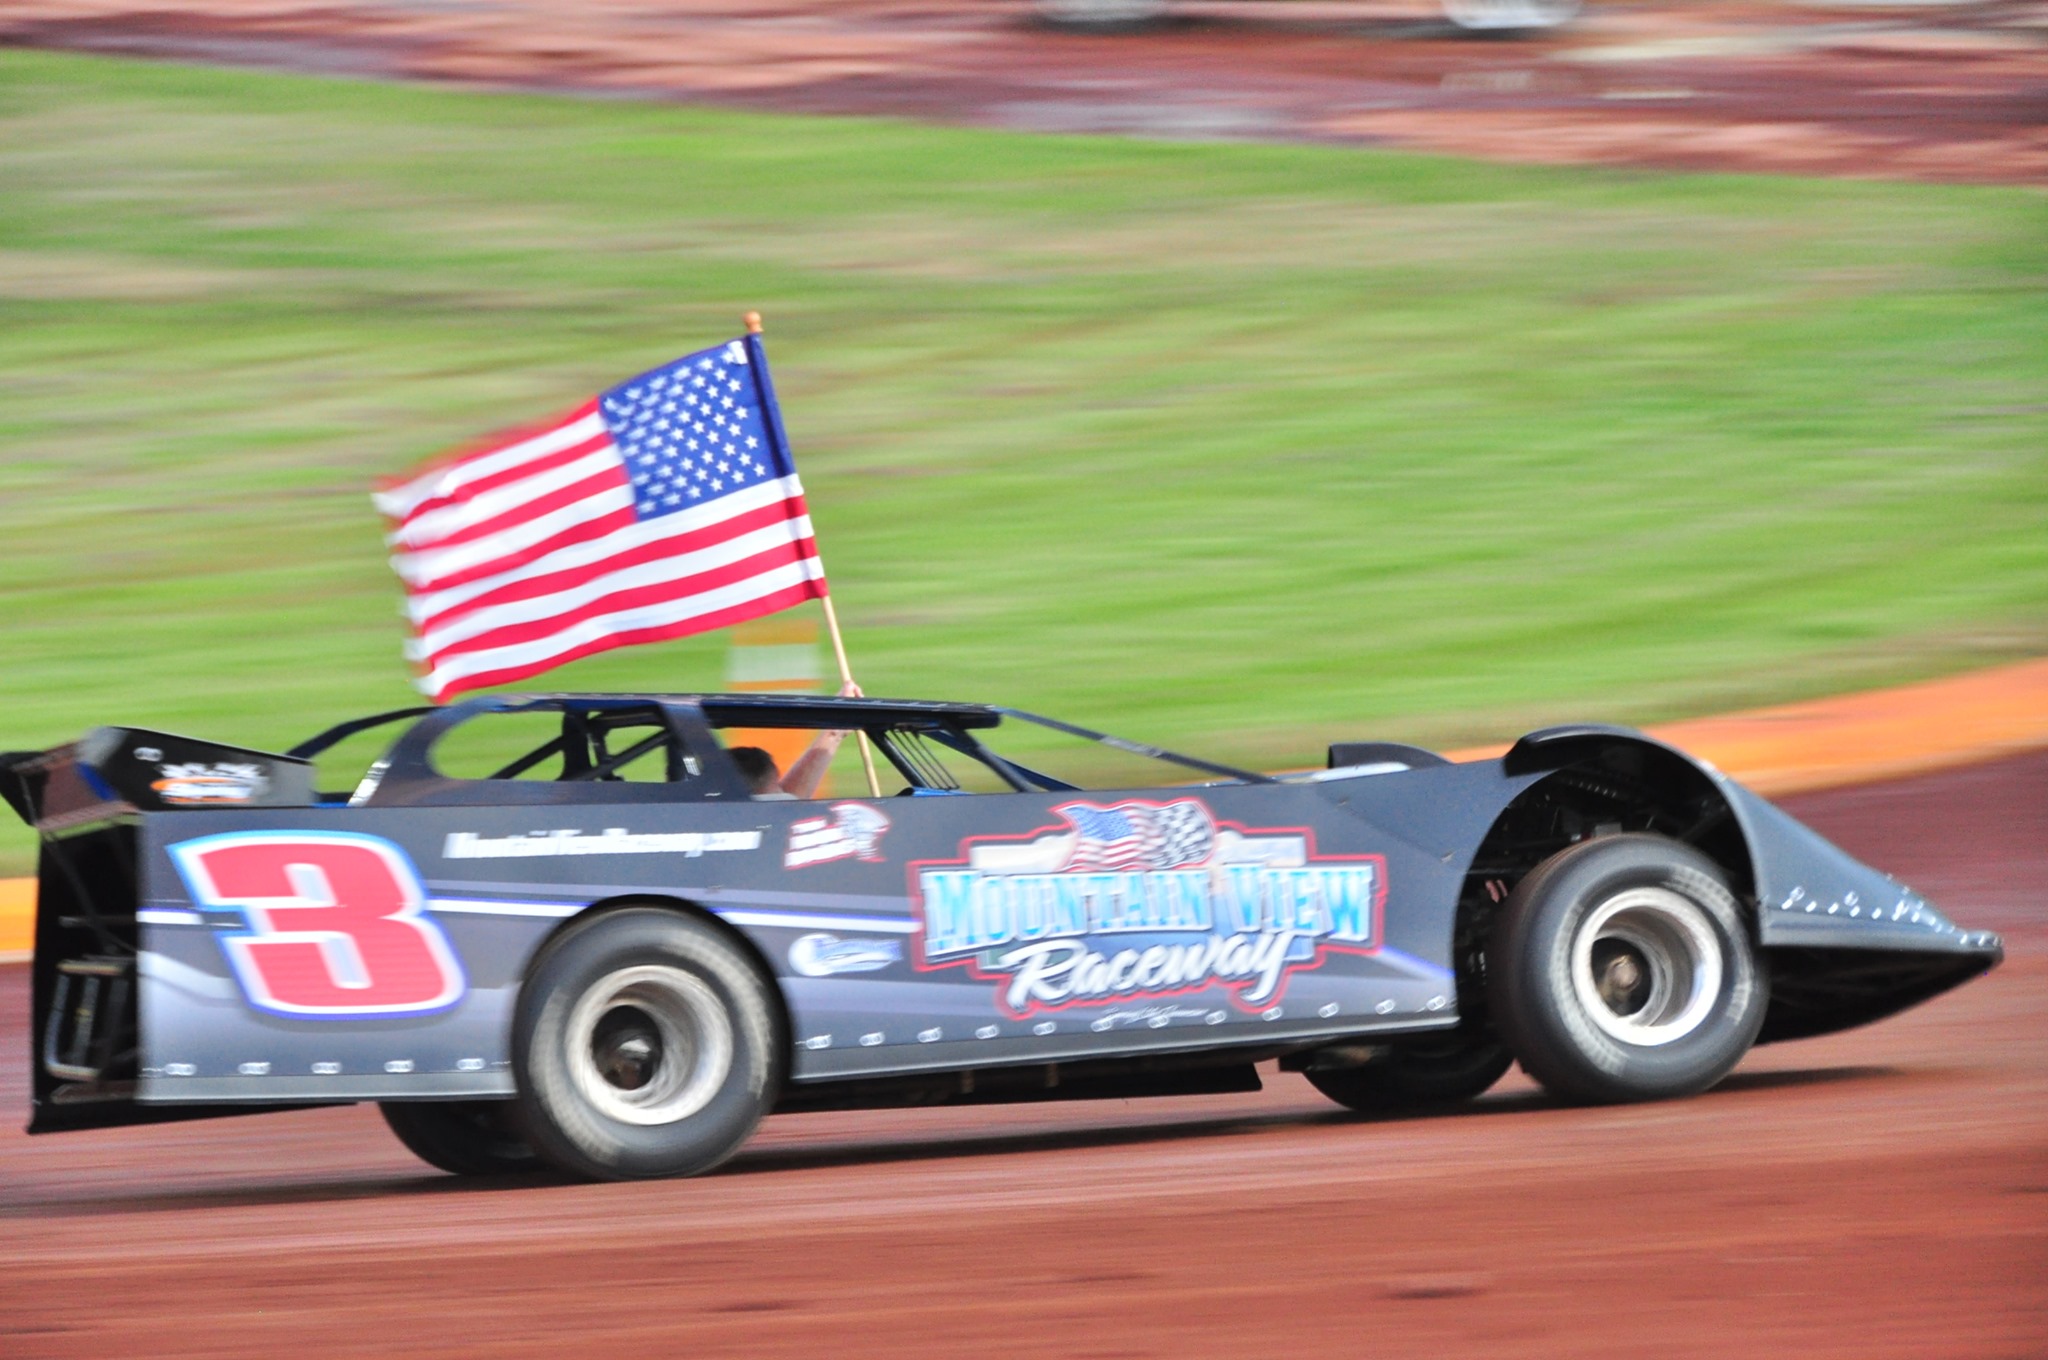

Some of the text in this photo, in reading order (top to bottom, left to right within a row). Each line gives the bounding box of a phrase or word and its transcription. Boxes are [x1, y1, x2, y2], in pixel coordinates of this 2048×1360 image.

[170, 832, 467, 1017] 3
[921, 867, 1214, 957] MOUNTAIN
[1223, 863, 1372, 943] VIEW
[1000, 932, 1294, 1014] Raceway
